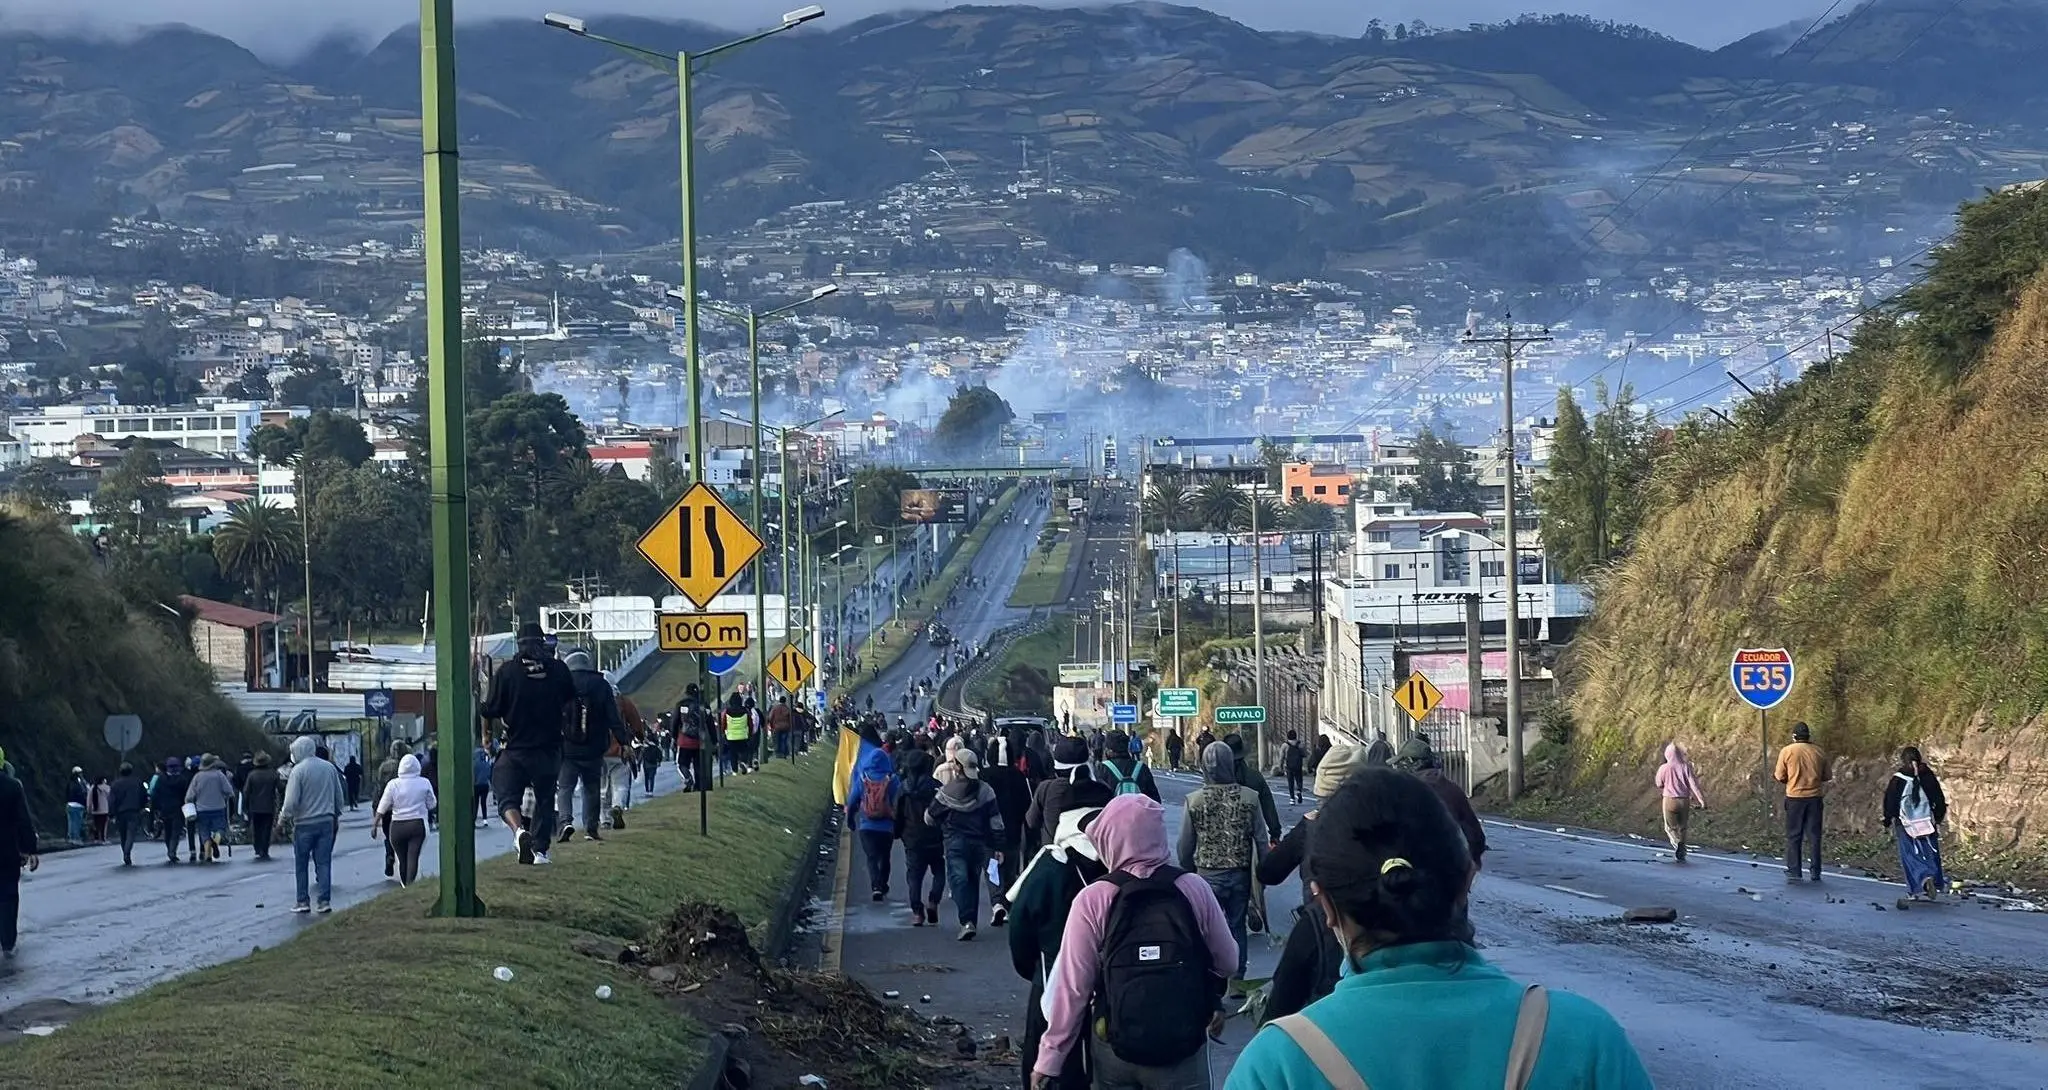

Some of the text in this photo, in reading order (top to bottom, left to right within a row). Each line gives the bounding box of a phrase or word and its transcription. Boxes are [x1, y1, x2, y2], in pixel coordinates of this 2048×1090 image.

[665, 622, 742, 642] 100 m
[1743, 653, 1781, 661] ECUADOR
[1741, 666, 1787, 690] E35
[1219, 711, 1261, 719] OTAVALO
